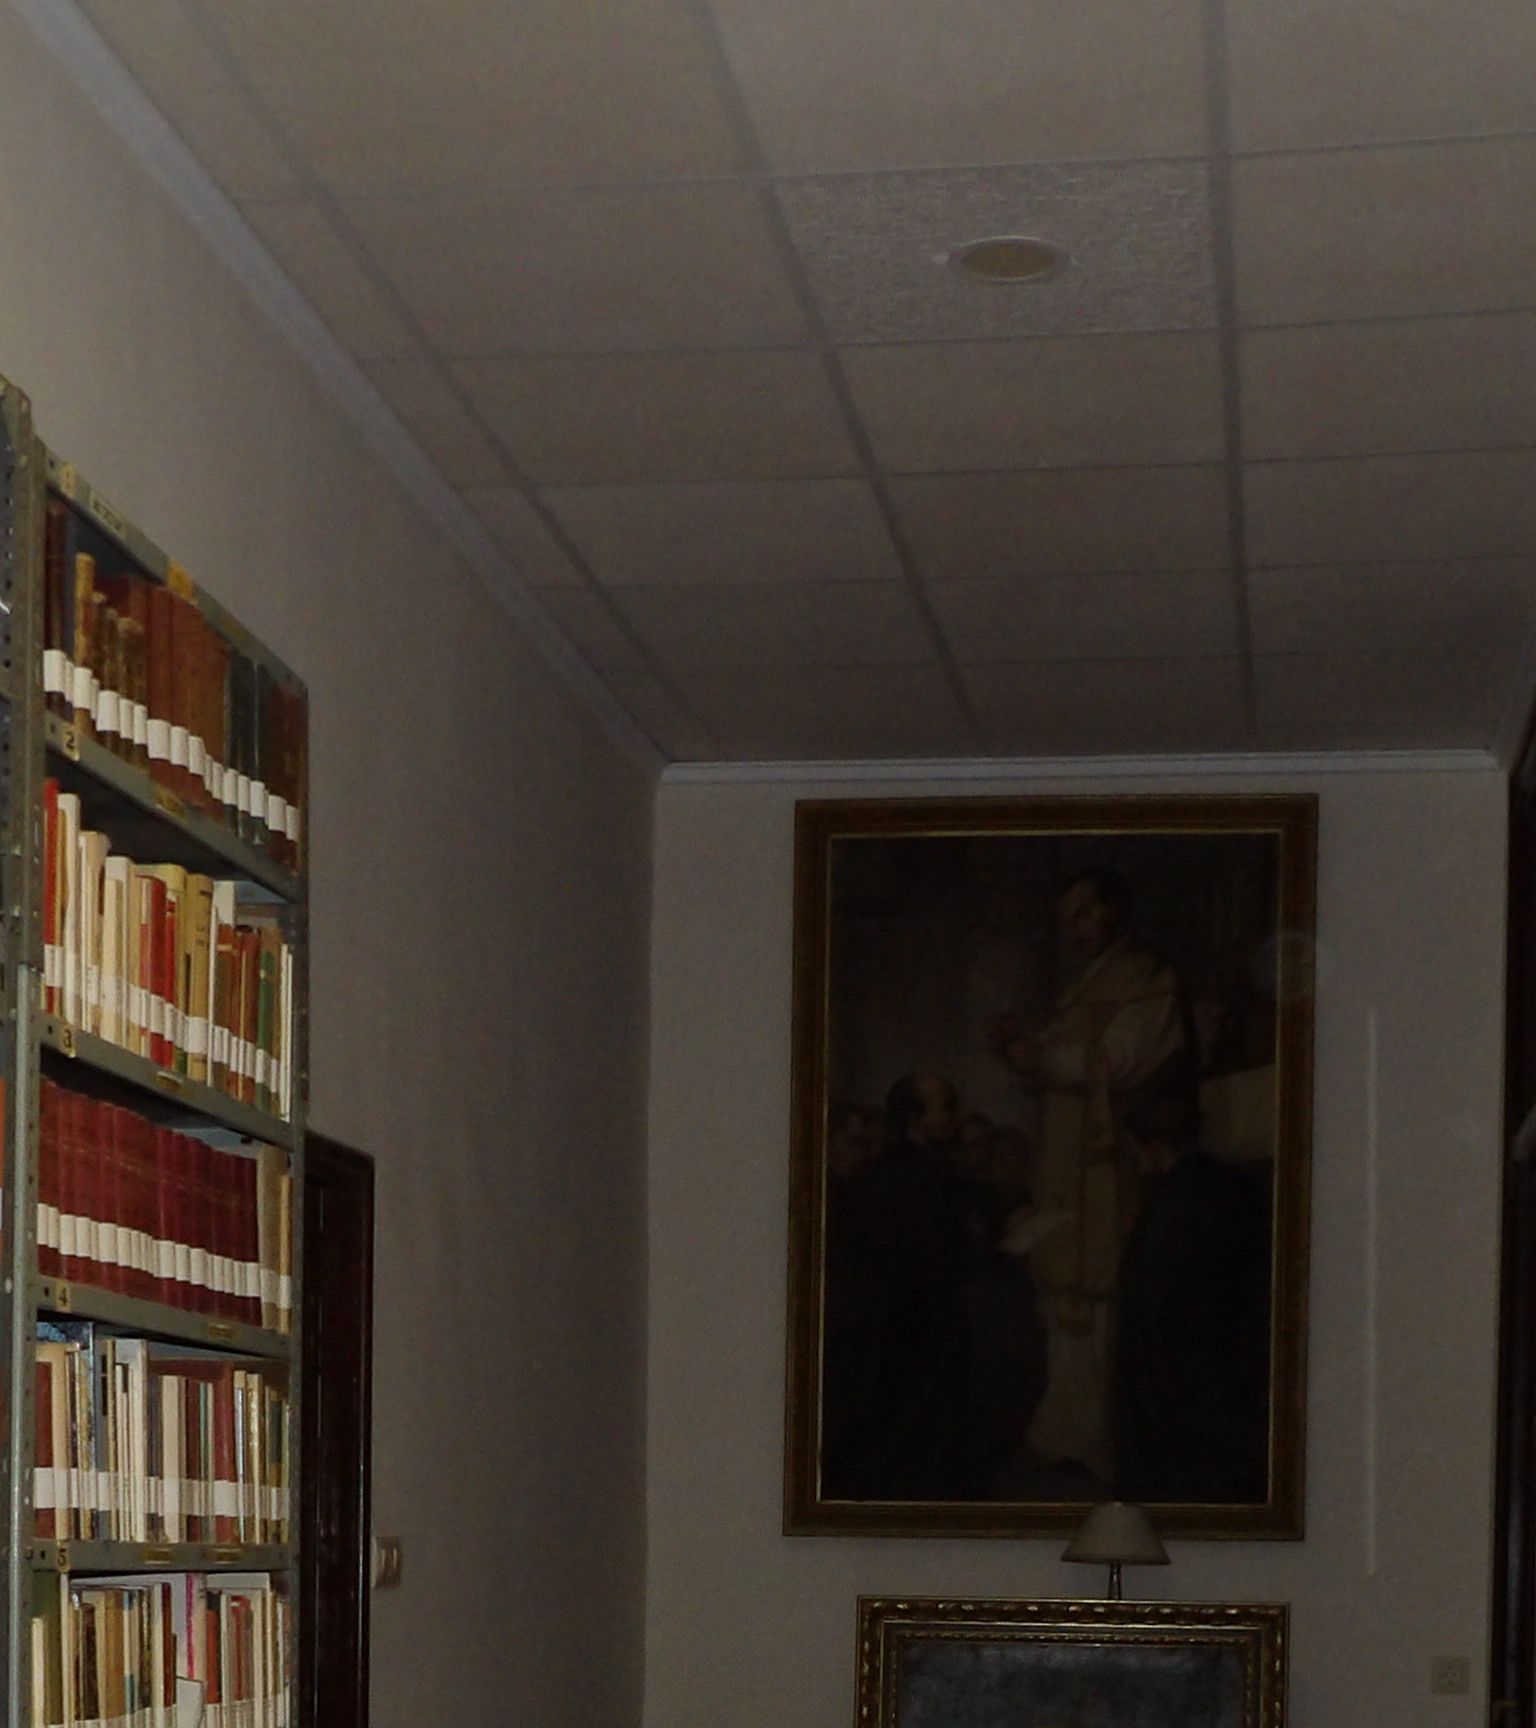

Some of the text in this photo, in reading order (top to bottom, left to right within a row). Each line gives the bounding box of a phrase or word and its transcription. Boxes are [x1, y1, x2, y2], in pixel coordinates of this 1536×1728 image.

[65, 732, 75, 749] 2
[63, 1030, 73, 1049] 3
[59, 1290, 69, 1306] 4
[57, 1547, 66, 1567] 5
